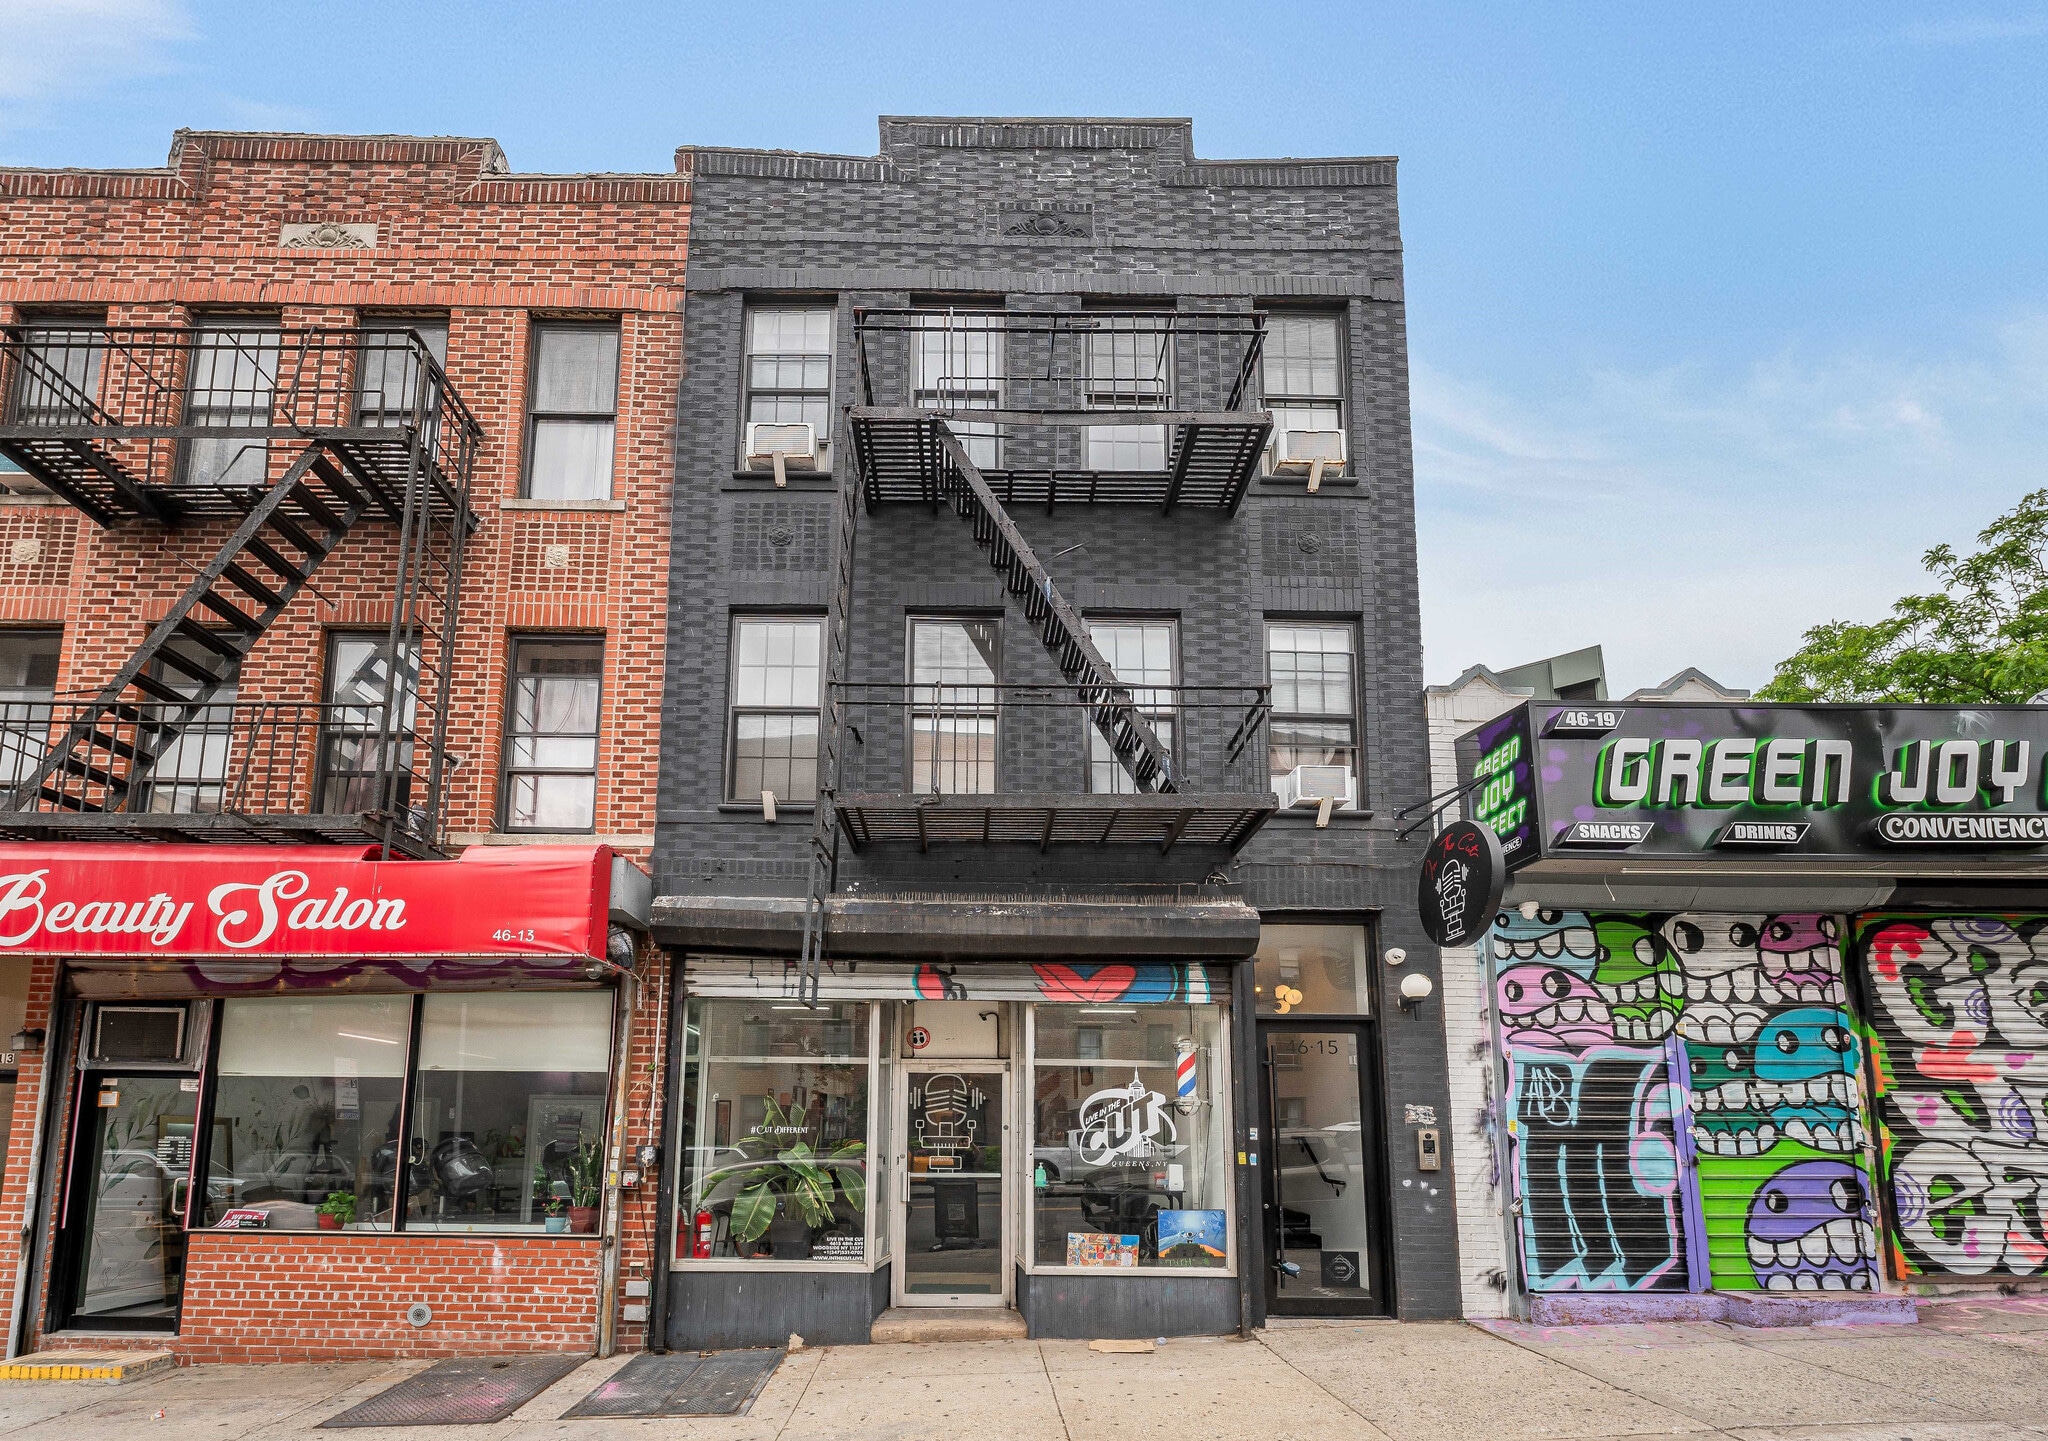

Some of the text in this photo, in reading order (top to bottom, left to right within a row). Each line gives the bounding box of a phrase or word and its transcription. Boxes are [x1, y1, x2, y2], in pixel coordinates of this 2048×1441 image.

[1565, 711, 1616, 726] 46-19
[1475, 737, 1519, 781] GREEN
[1608, 737, 2030, 803] GREEN JOY
[1477, 770, 1513, 817] JOY
[1579, 825, 1641, 840] SNACKS
[1734, 824, 1798, 841] DRINKS
[0, 868, 407, 948] Beauty Salon
[492, 929, 535, 942] 46-13
[1080, 1091, 1166, 1166] CUT
[1085, 1098, 1122, 1125] LIVE IN THE
